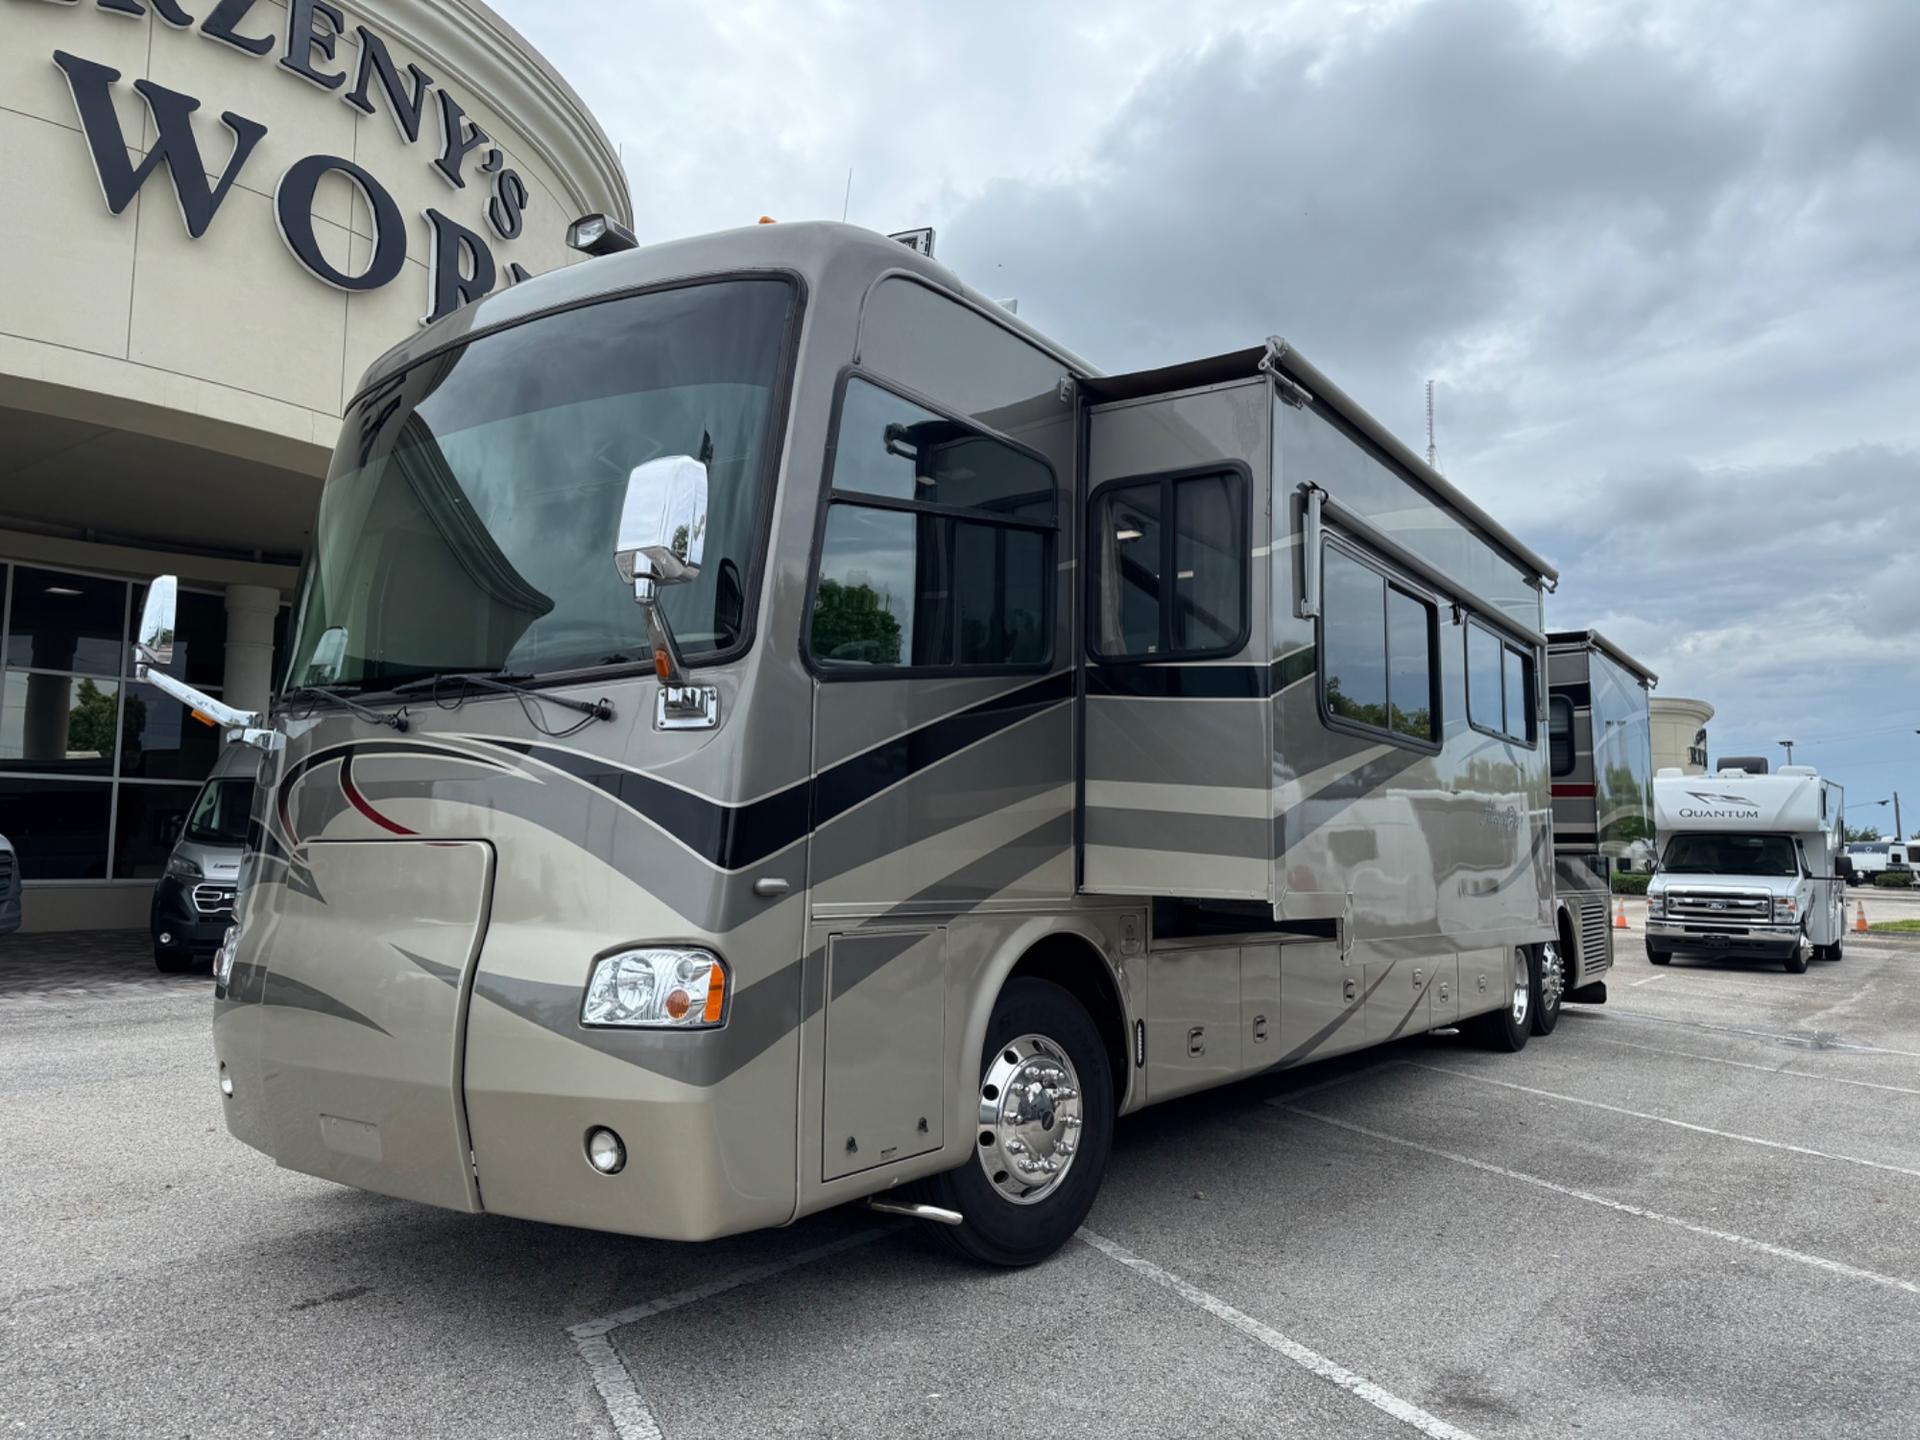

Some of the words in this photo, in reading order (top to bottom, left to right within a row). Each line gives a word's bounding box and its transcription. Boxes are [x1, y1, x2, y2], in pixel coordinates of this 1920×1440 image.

[43, 0, 529, 240] ZENY'S
[51, 49, 533, 327] WOR
[1679, 808, 1758, 818] QUANTUM
